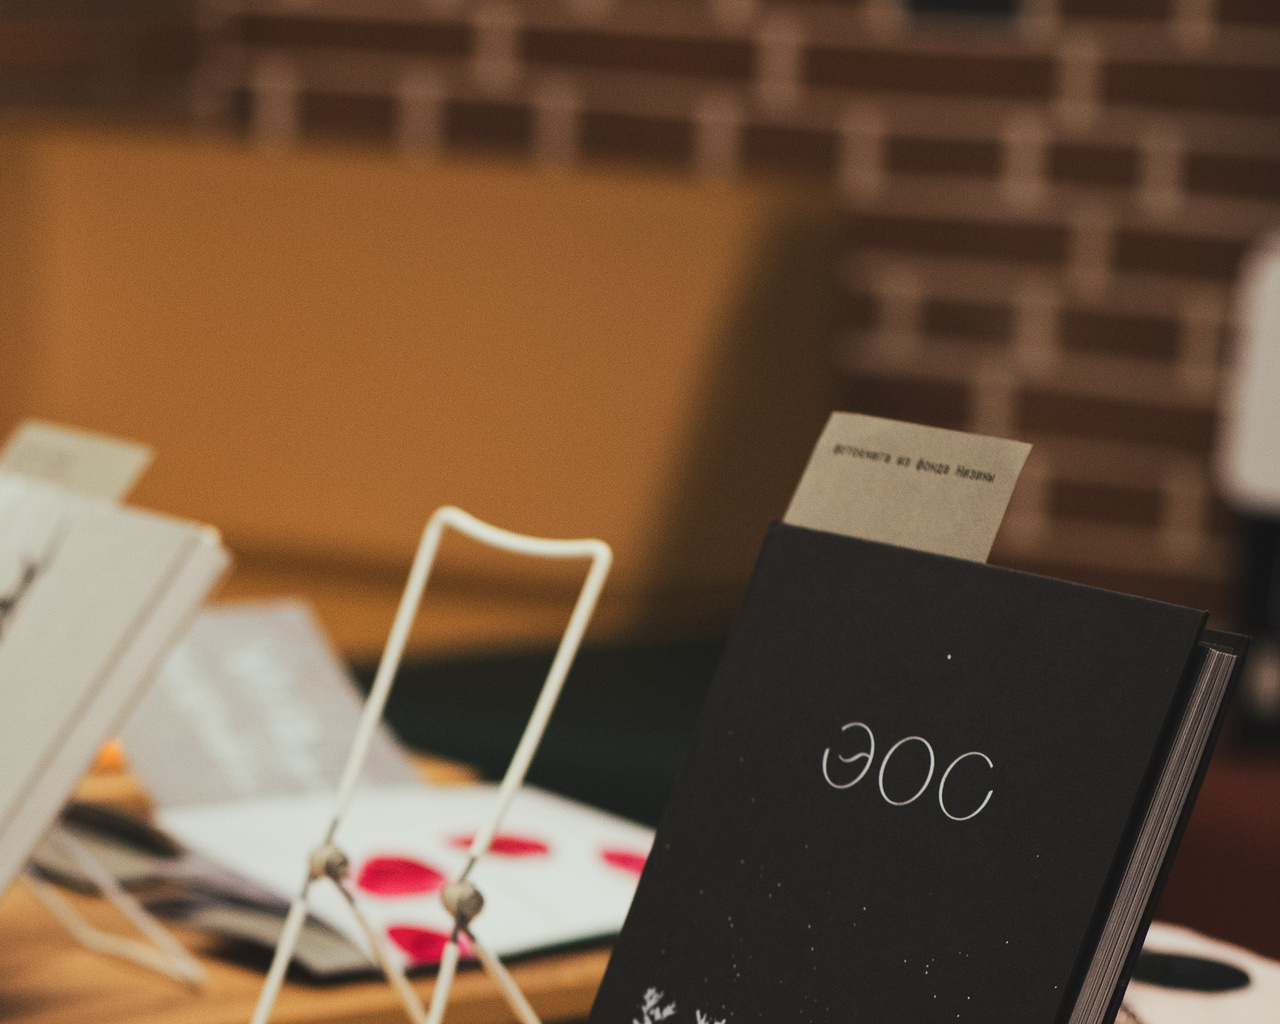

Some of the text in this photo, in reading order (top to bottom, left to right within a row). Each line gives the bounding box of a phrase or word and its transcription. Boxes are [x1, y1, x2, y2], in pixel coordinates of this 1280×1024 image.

[895, 456, 911, 469] из
[915, 458, 951, 475] фонда
[822, 721, 994, 821] ЭОС
